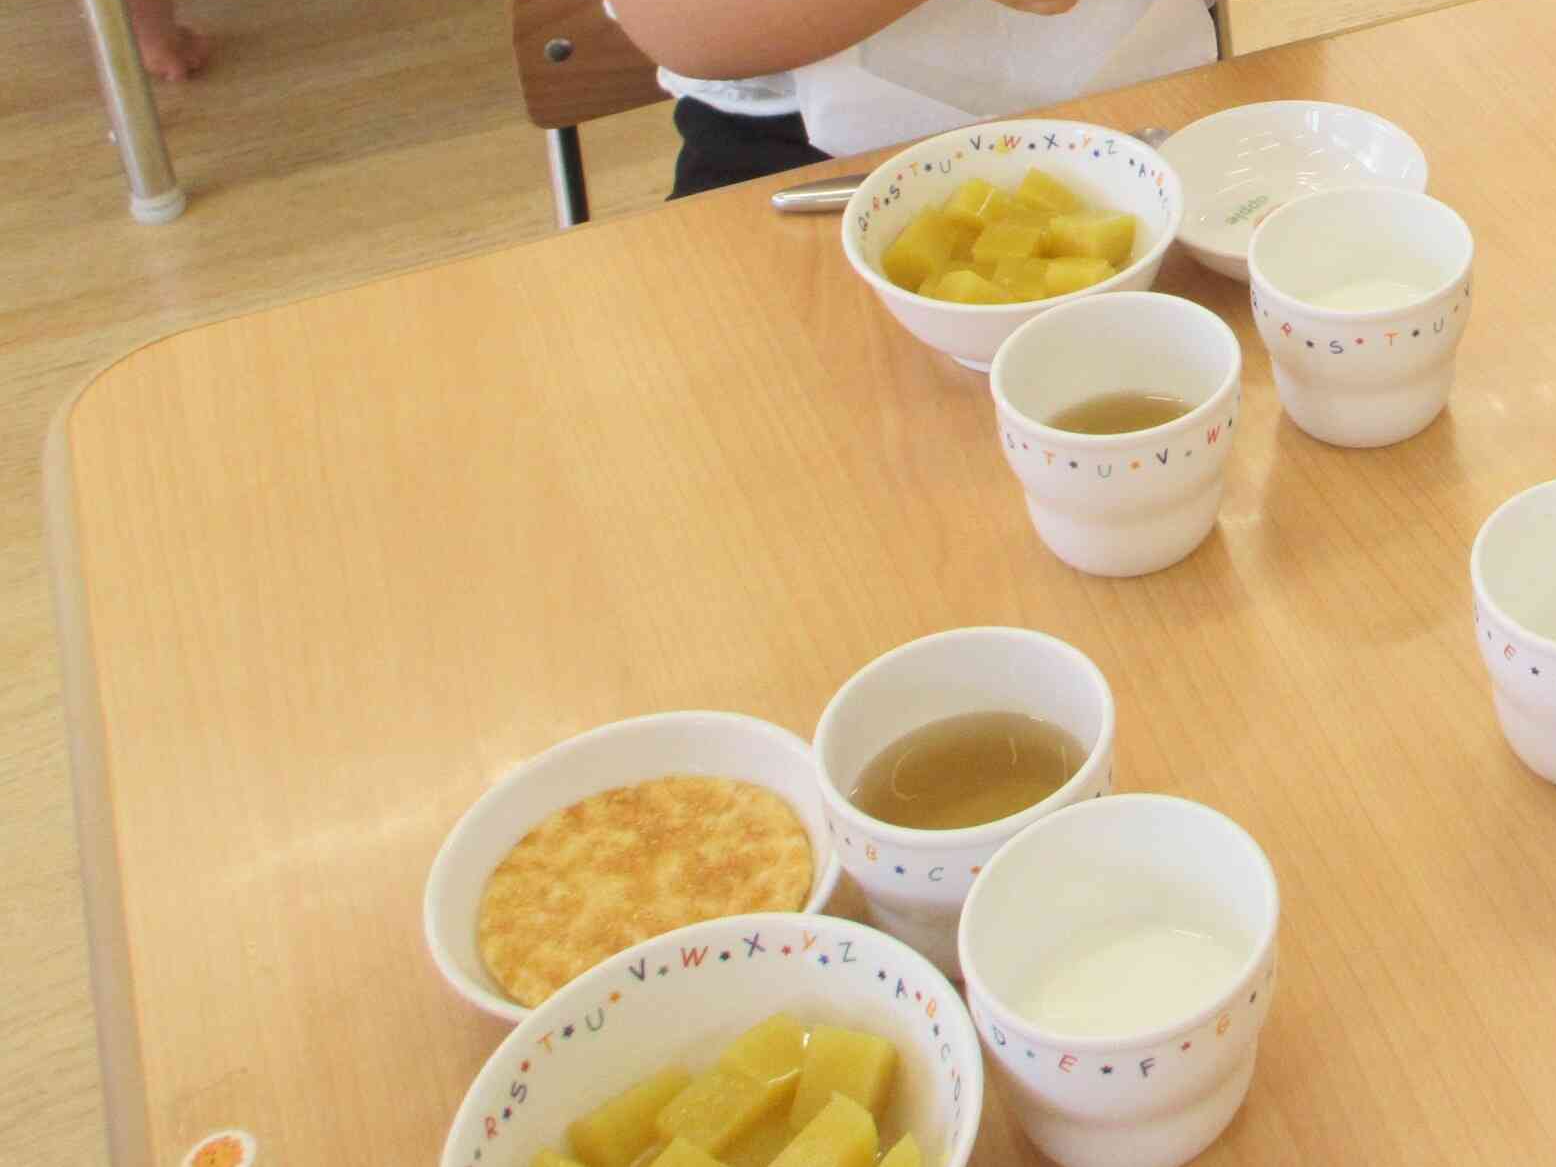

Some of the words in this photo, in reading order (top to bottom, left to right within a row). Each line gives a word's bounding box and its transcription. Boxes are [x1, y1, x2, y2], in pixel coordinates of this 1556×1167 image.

[939, 159, 951, 174] U
[970, 135, 982, 151] V
[1003, 134, 1021, 149] W
[1044, 133, 1059, 150] X
[1105, 139, 1119, 155] Z
[1328, 339, 1344, 355] S
[1384, 331, 1400, 347] T
[1433, 316, 1445, 333] U
[1096, 464, 1112, 479] U
[1155, 447, 1169, 466] V
[1206, 425, 1221, 445] W
[1503, 643, 1517, 661] E
[928, 866, 945, 882] C
[485, 1116, 499, 1138] R
[510, 1081, 528, 1104] S
[536, 1032, 553, 1053] T
[585, 1007, 605, 1032] U
[628, 958, 646, 982] V
[680, 945, 709, 968] W
[742, 932, 766, 958] X
[837, 940, 856, 963] Z
[895, 977, 908, 999] A
[1058, 1053, 1078, 1074] E
[1139, 1057, 1156, 1078] F
